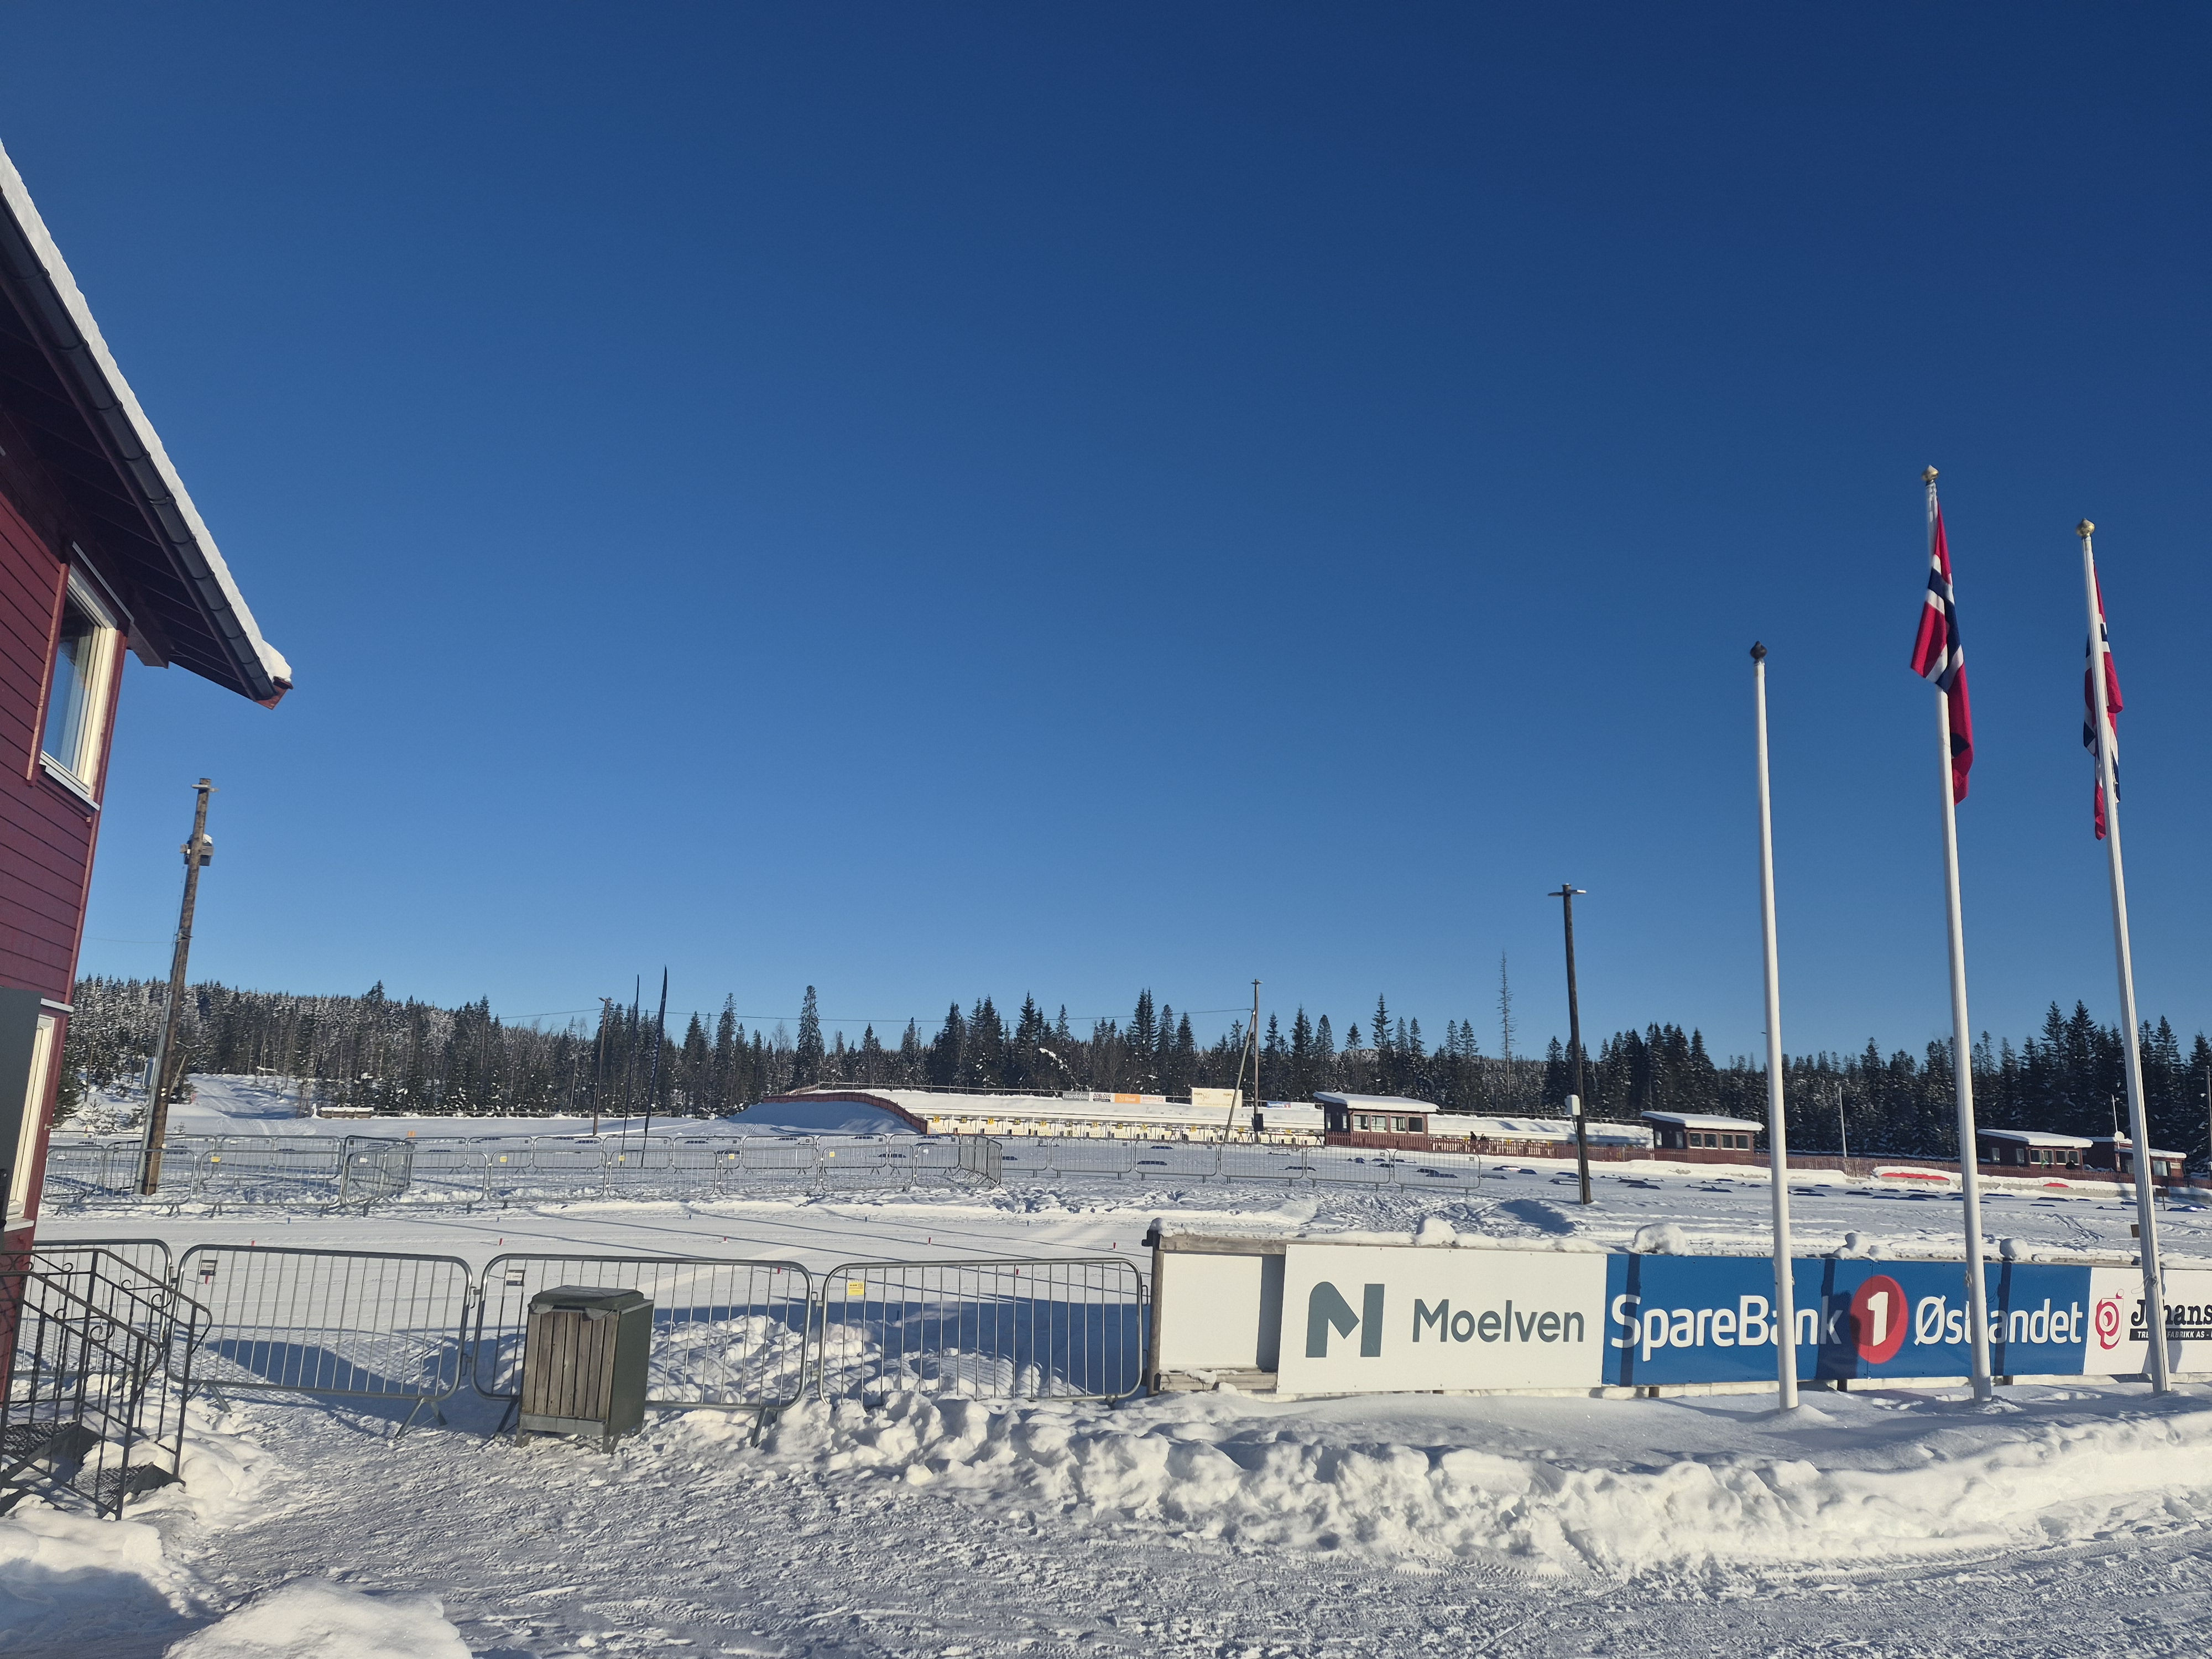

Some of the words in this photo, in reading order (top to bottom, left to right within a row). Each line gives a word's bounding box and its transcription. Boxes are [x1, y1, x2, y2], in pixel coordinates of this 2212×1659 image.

[1412, 1298, 1585, 1343] Moelven
[1867, 1291, 1889, 1347] 1
[1914, 1295, 2083, 1346] Østandet
[2131, 1298, 2212, 1327] Jhans
